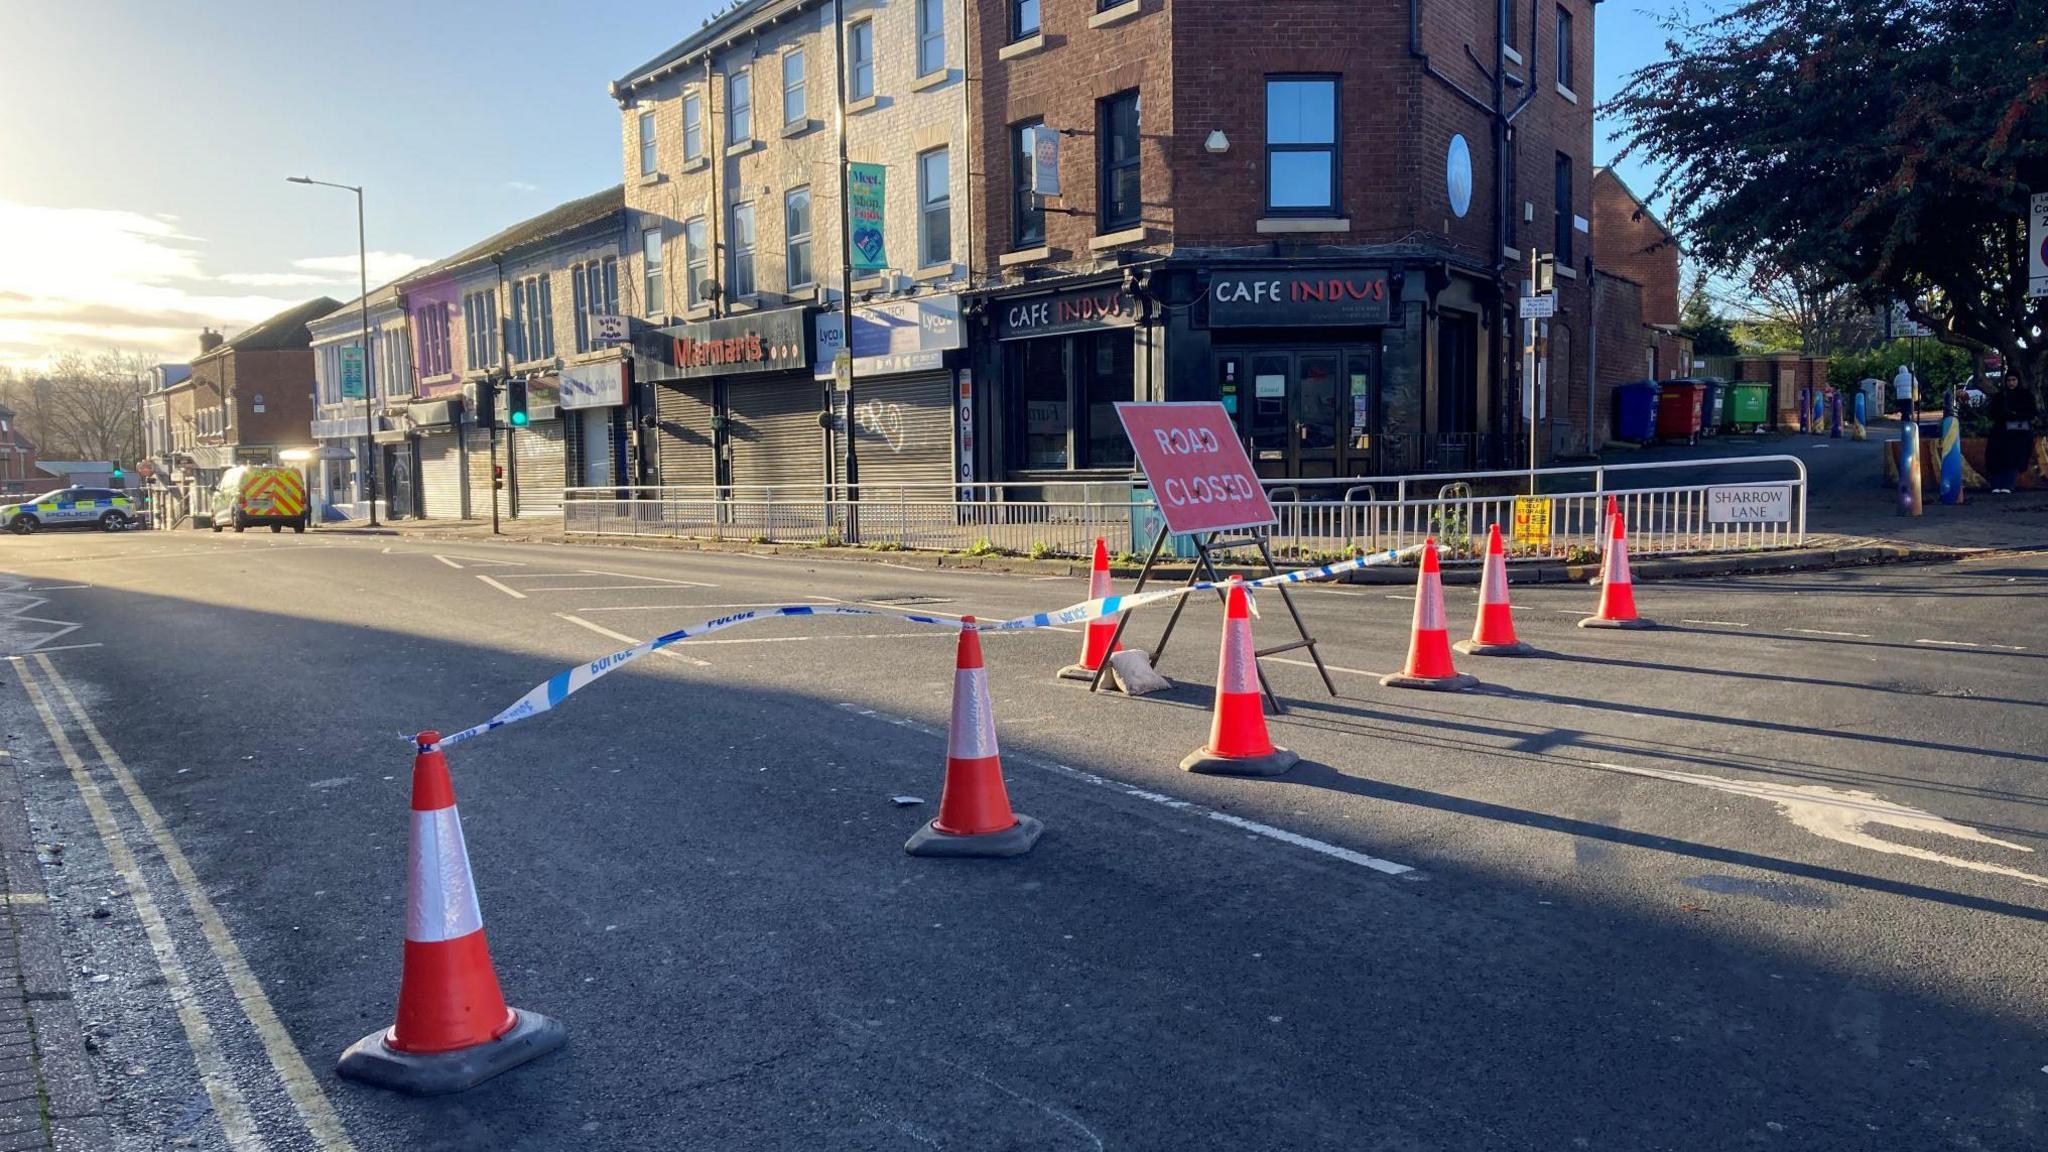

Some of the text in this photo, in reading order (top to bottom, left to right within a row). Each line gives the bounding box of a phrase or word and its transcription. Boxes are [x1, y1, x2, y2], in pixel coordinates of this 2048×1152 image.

[853, 171, 881, 184] Meet.
[1216, 279, 1386, 303] CAFE INDUS
[1009, 302, 1049, 328] CAFE
[1058, 292, 1120, 321] INDUS
[1154, 427, 1219, 455] ROAD
[1164, 474, 1254, 506] CLOSED
[1715, 491, 1783, 503] SHARROW
[46, 510, 98, 518] POLICE
[1731, 506, 1767, 518] LANE
